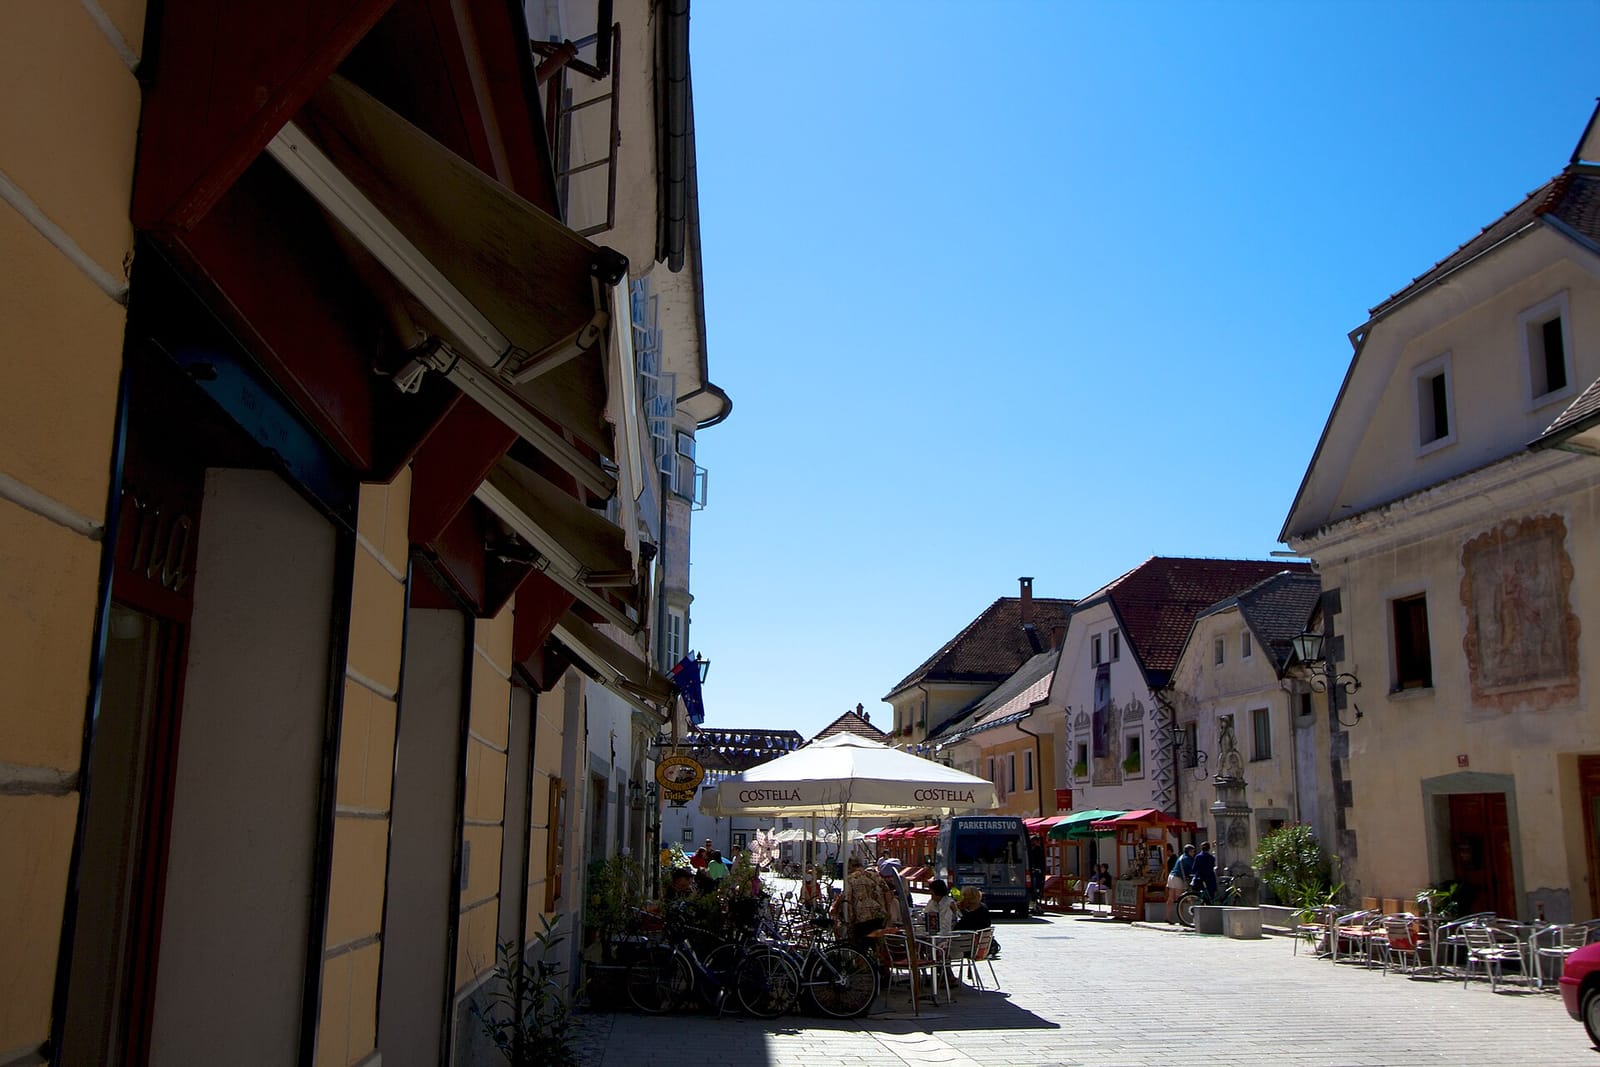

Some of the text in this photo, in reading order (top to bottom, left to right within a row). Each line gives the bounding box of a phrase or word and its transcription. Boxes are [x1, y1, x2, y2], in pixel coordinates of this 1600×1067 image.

[739, 787, 801, 803] COSTELLA
[914, 788, 975, 803] COSTELLA
[958, 820, 1017, 830] PARKETARSTVO
